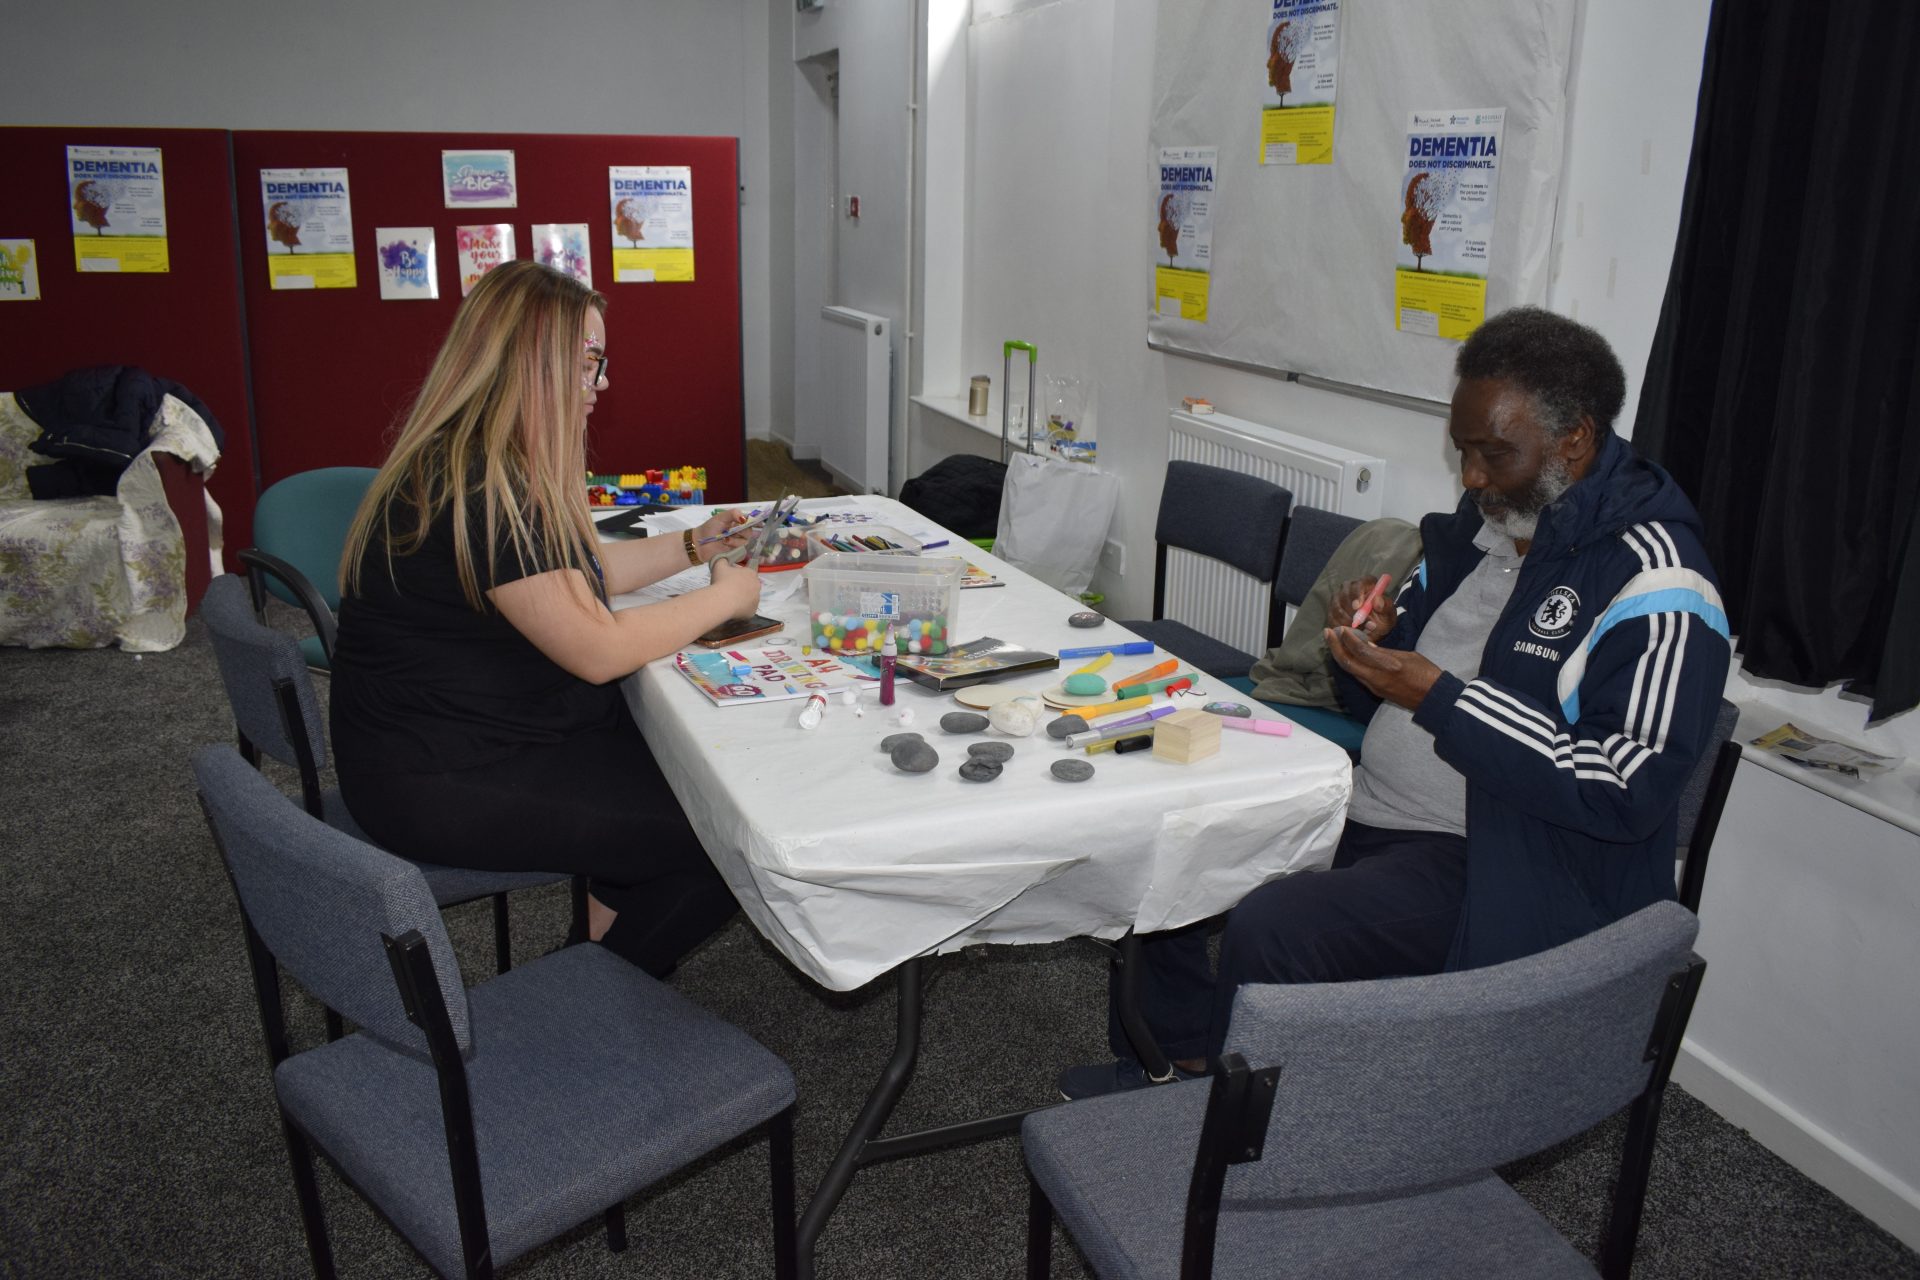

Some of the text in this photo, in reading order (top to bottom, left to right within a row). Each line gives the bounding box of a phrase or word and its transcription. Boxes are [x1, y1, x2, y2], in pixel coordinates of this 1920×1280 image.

[1409, 136, 1497, 157] DEMENTIA
[73, 160, 158, 173] DEMENTIA
[1408, 160, 1427, 168] DOES
[1427, 160, 1441, 168] NOT
[1161, 167, 1213, 182] DEMENTIA
[266, 182, 345, 193] DEMENTIA
[462, 176, 499, 191] BIG
[614, 180, 687, 190] DEMENTIA
[752, 664, 786, 682] PAD
[803, 659, 843, 673] A4
